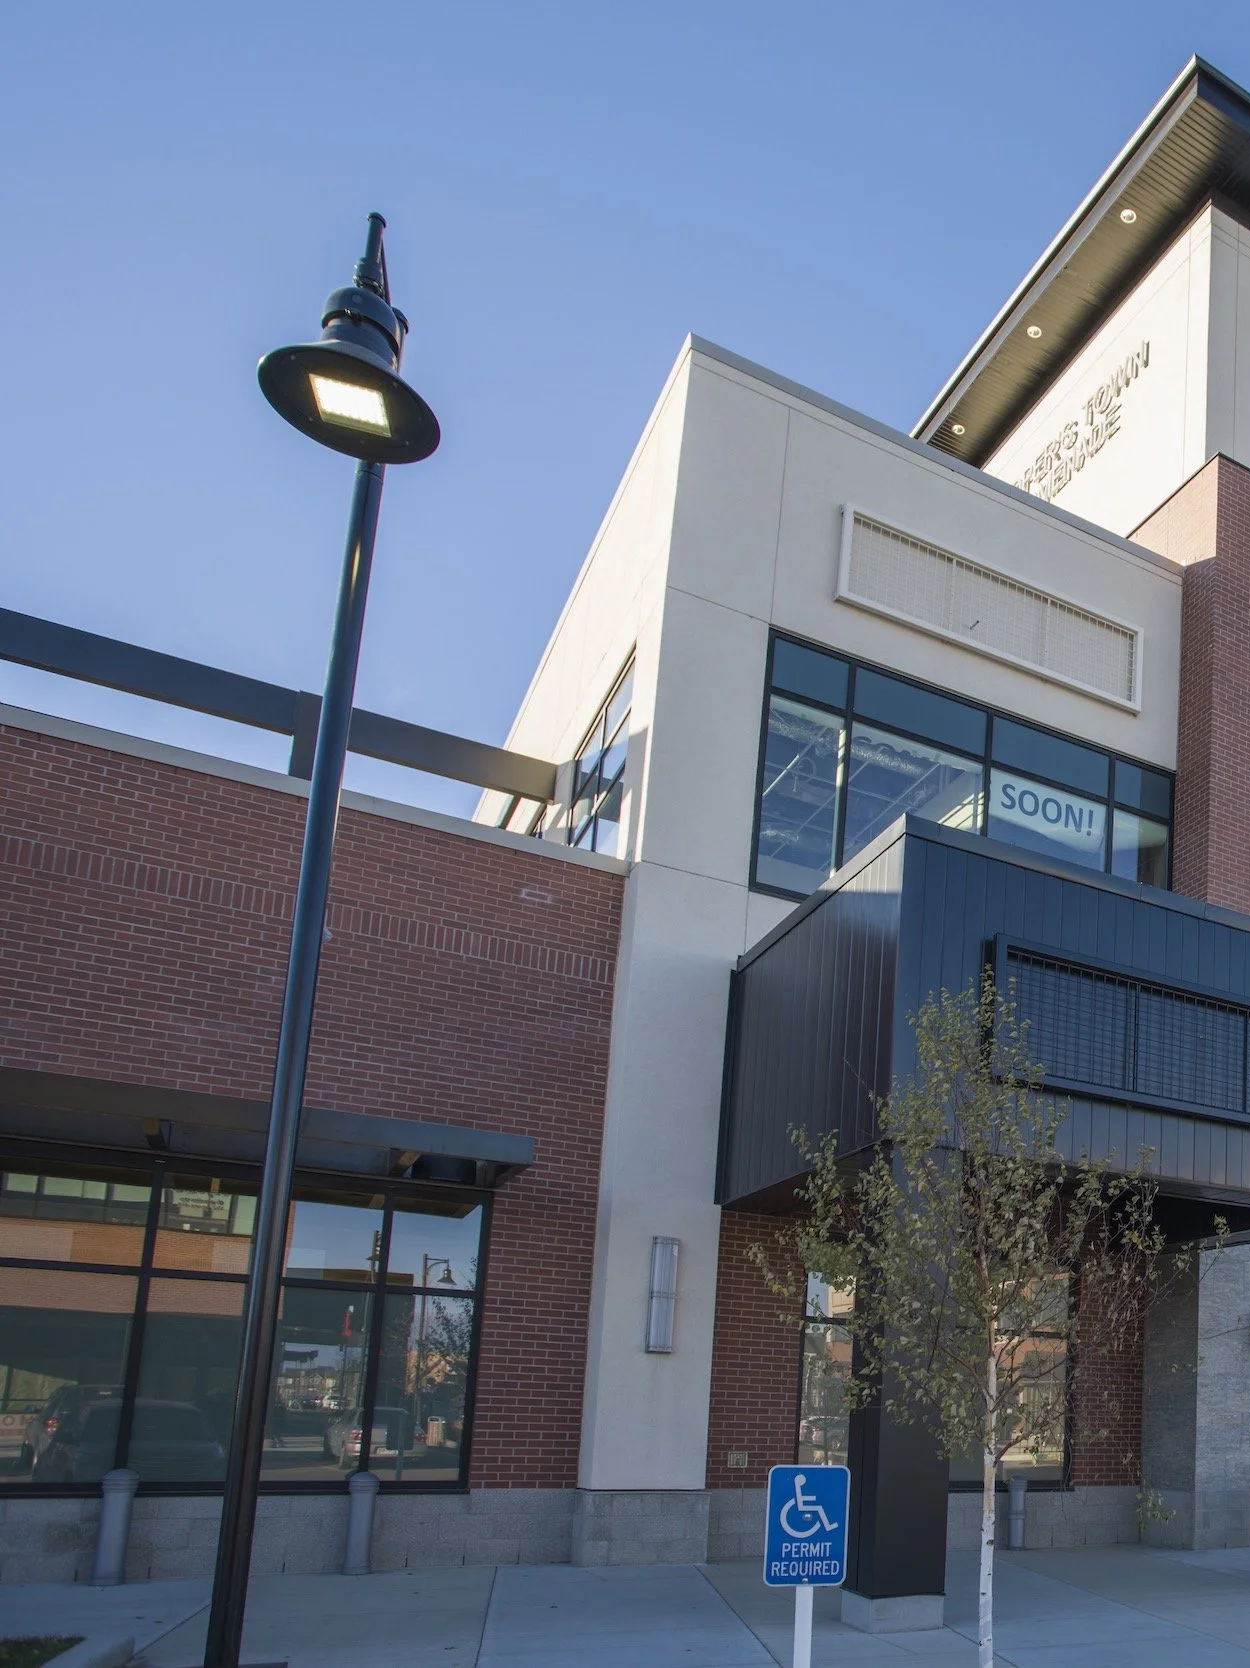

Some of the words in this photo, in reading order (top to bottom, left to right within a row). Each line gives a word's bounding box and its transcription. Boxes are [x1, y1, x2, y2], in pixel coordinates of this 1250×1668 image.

[1083, 339, 1150, 426] TOWN
[1000, 783, 1094, 837] SOON!
[781, 1542, 832, 1558] PERMIT
[771, 1560, 840, 1577] REQUIRED
